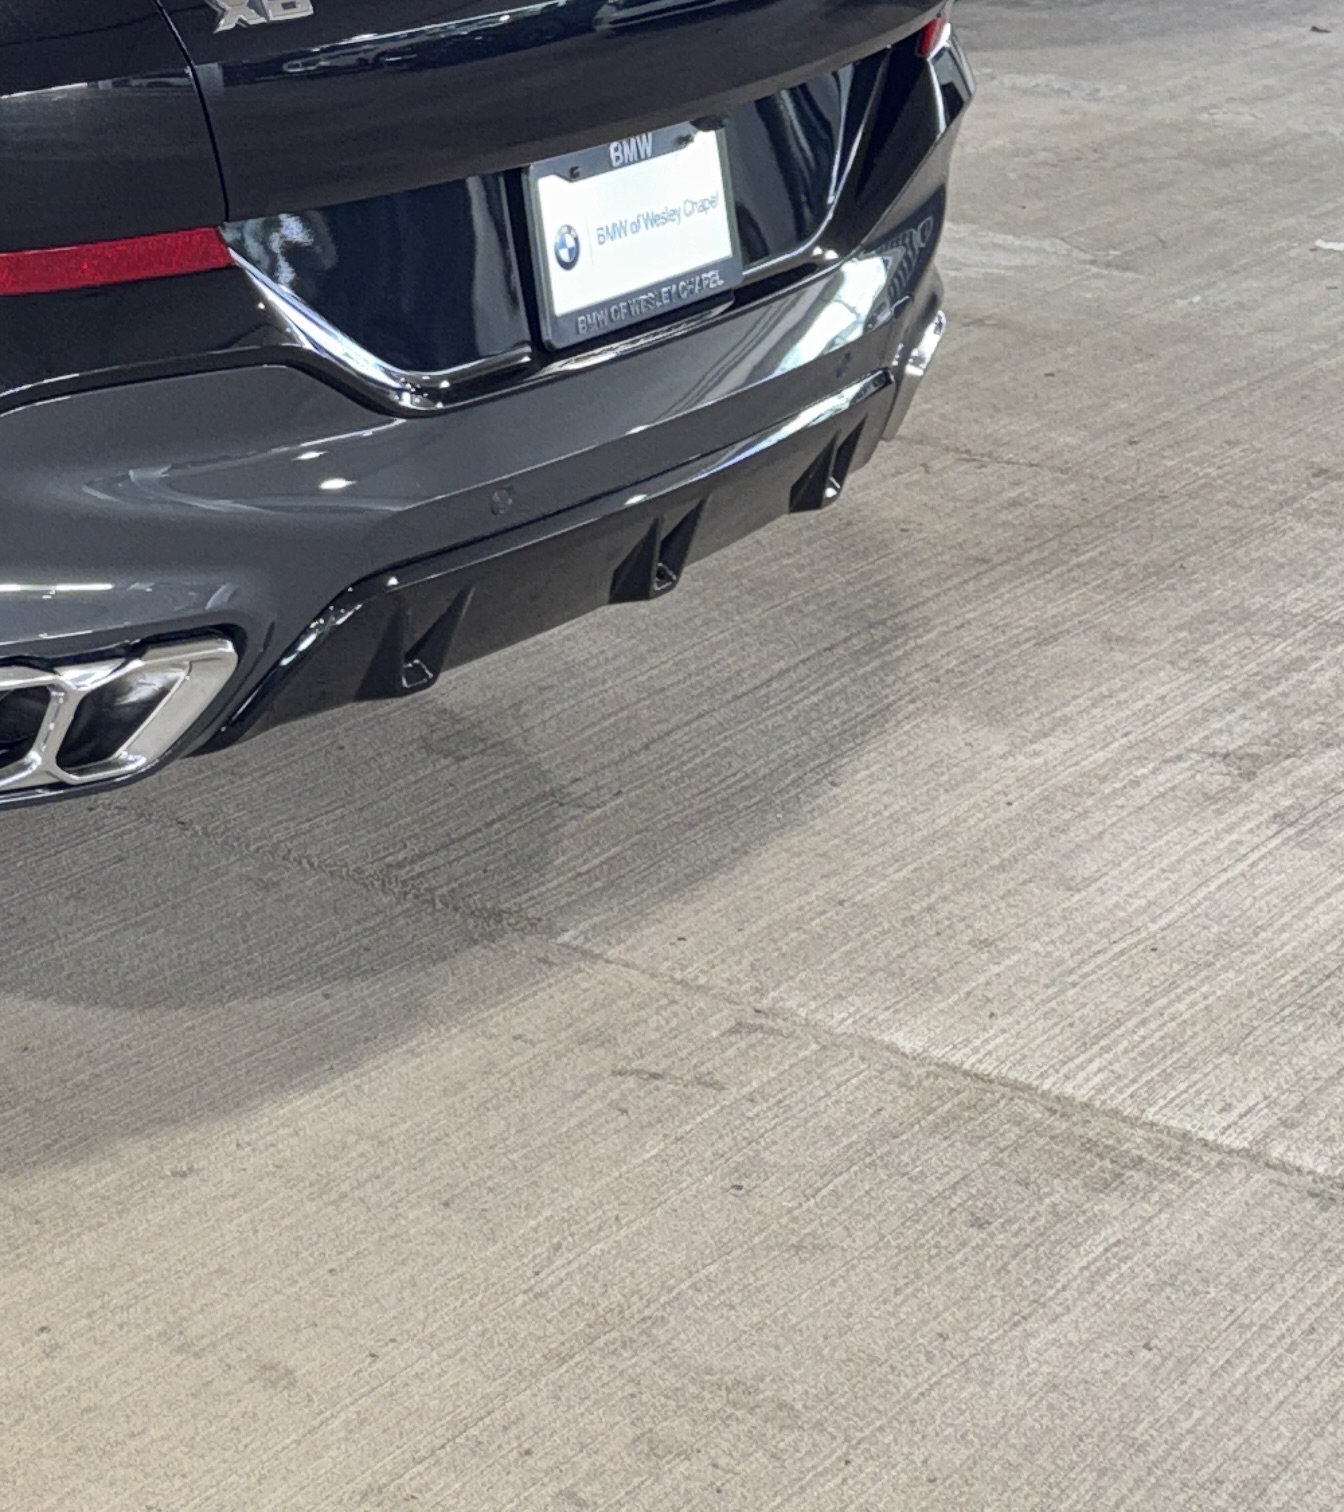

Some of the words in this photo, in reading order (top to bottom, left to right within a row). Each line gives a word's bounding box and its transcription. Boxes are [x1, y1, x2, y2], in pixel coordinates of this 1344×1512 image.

[610, 131, 653, 168] BMW
[596, 219, 628, 245] BMW
[630, 213, 643, 235] of
[642, 206, 681, 230] Wesley
[683, 190, 719, 217] Chapel
[577, 309, 608, 335] BMW
[611, 300, 628, 322] OF
[627, 284, 676, 317] WESLEY
[678, 269, 725, 299] CHAPEL
